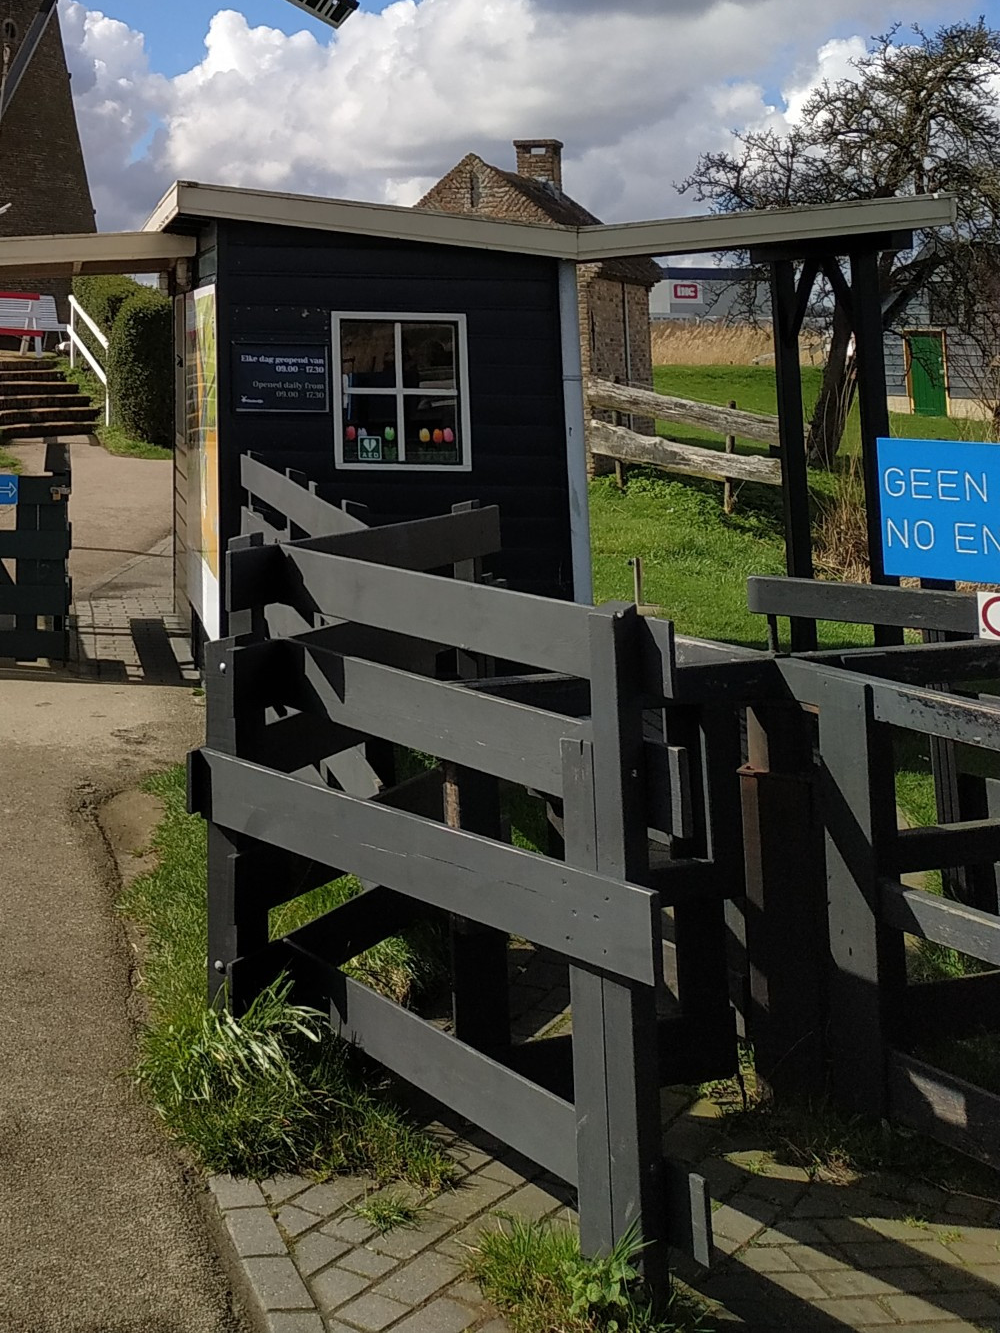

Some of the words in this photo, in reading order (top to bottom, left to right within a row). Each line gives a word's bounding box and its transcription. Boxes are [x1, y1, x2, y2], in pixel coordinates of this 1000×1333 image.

[241, 354, 258, 362] Elke
[259, 355, 274, 364] dag
[275, 356, 308, 364] geopend
[310, 357, 324, 365] van
[276, 365, 299, 373] 09.00
[306, 366, 325, 374] 17.30
[252, 381, 282, 389] Opened
[283, 381, 302, 390] daily
[304, 382, 324, 390] from
[276, 390, 299, 398] 09.00
[306, 391, 325, 399] 17.30
[884, 467, 988, 503] GEEN
[886, 517, 935, 551] NO
